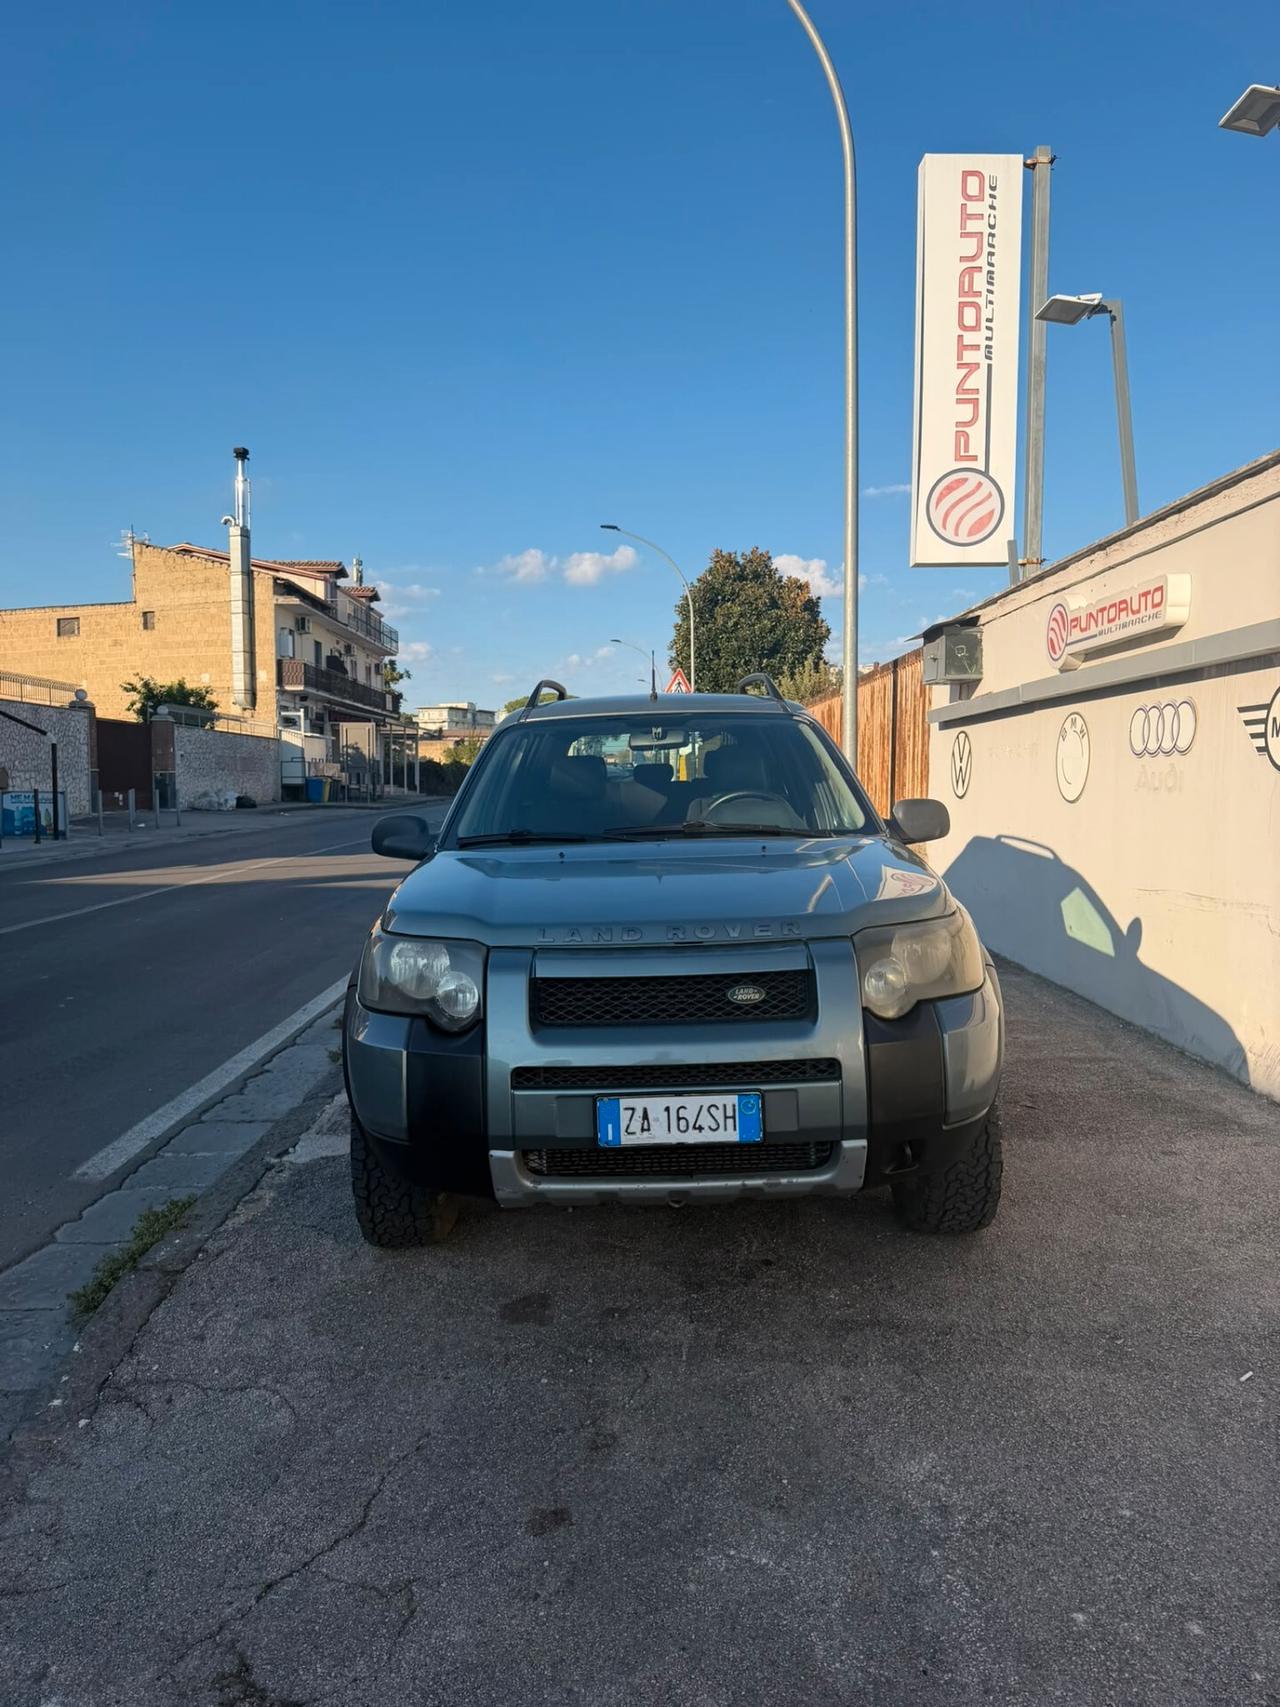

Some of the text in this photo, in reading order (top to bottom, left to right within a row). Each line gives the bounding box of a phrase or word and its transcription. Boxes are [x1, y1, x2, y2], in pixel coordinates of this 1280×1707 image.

[985, 174, 998, 361] MULTIMARCHE
[955, 170, 986, 462] PUNTOAUTO
[1069, 585, 1164, 637] PUNTOAUTO
[1097, 610, 1162, 637] MULTIMARCHE
[536, 920, 802, 944] LAND ROVER
[623, 1103, 737, 1135] ZA 164SH
